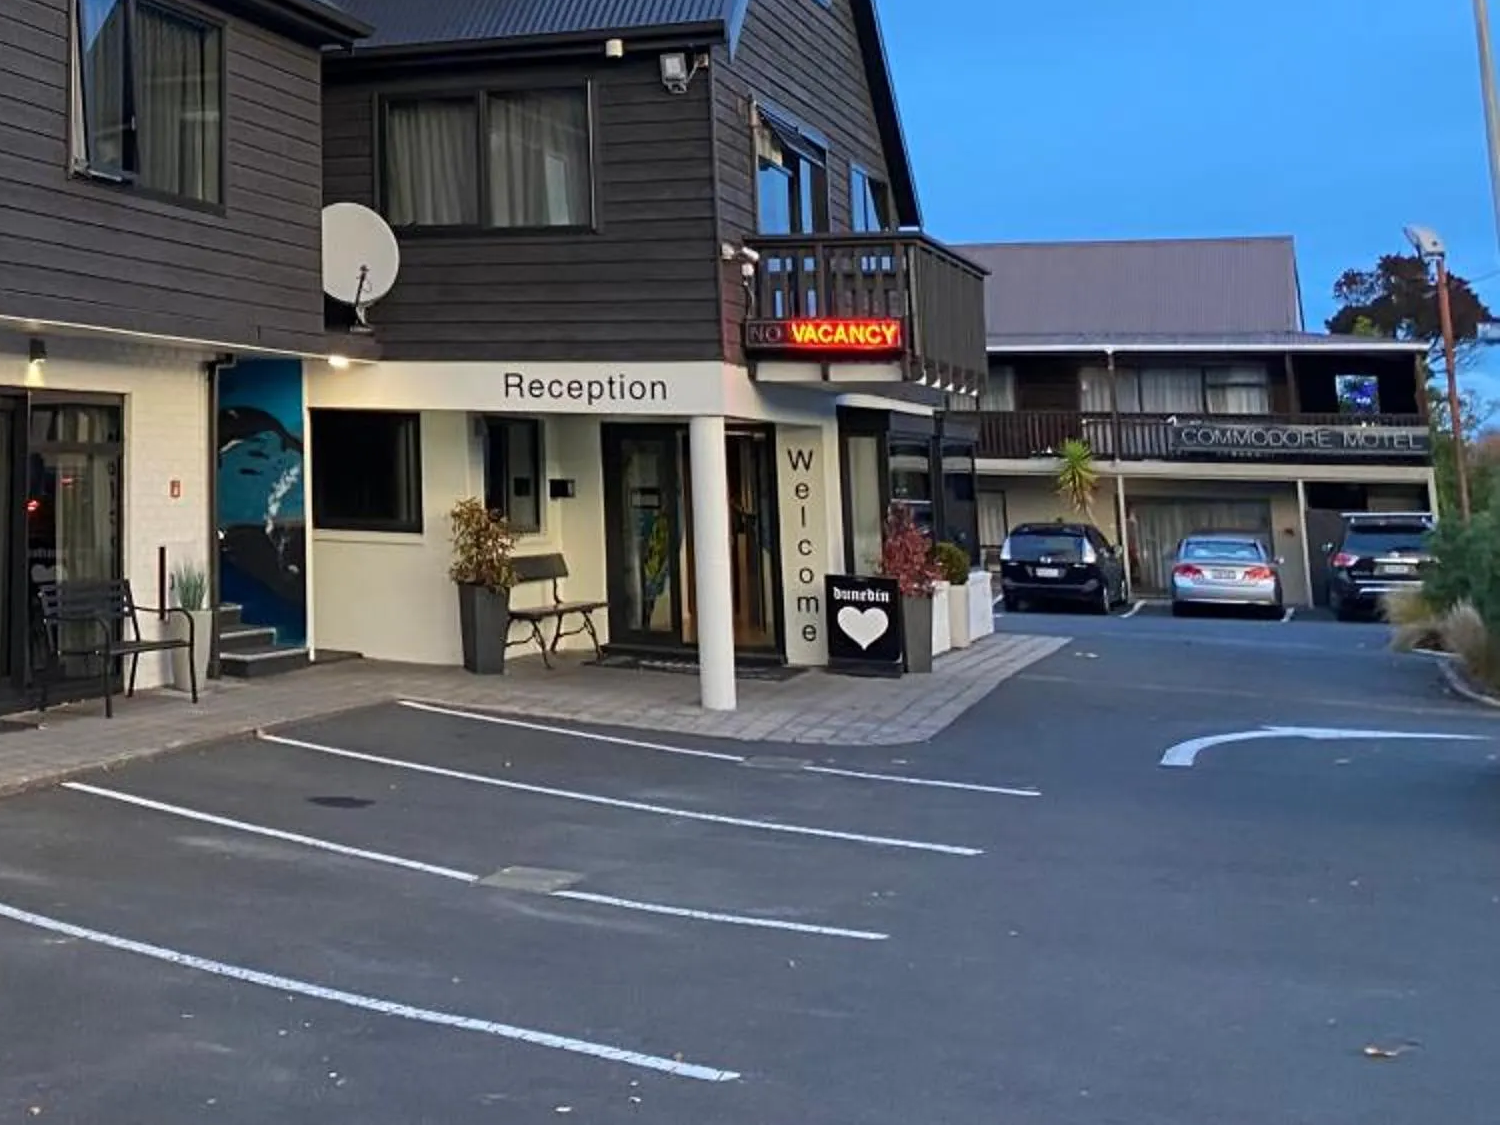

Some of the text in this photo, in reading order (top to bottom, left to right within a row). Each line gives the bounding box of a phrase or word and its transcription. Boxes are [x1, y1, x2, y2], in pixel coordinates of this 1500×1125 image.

[751, 323, 897, 345] NO VACANCY
[504, 373, 667, 405] Reception
[1182, 428, 1423, 449] COMMODORE MOTEL
[787, 448, 819, 642] Welcome
